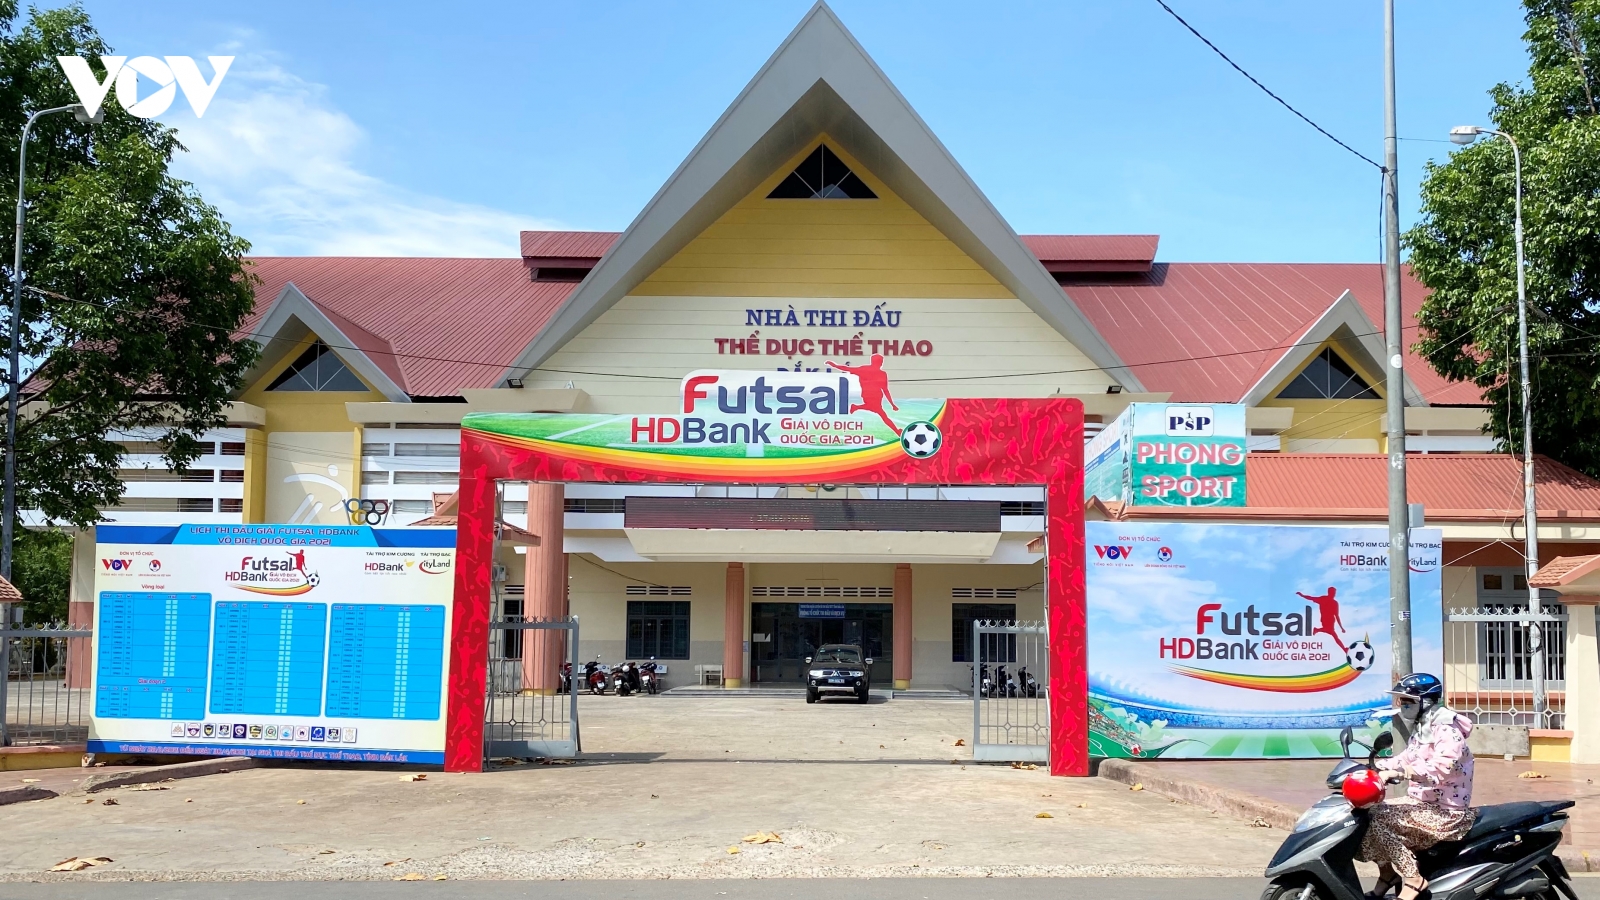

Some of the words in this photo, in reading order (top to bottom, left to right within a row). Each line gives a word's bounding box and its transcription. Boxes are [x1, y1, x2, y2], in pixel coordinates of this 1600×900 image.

[745, 305, 800, 326] NHÀ
[804, 310, 847, 326] THI
[853, 302, 902, 328] ĐẤU
[714, 330, 760, 355] THỂ
[766, 338, 814, 360] DỤC
[818, 332, 864, 356] THỂ
[868, 340, 934, 356] THAO
[684, 376, 850, 414] Futsal
[631, 417, 772, 444] HDBank
[780, 418, 808, 430] GIẢI
[812, 418, 831, 430] VÔ
[834, 420, 863, 432] ĐỊCH
[780, 432, 817, 444] QUỐC
[820, 434, 842, 444] GIA
[844, 435, 874, 445] 2021
[1137, 442, 1243, 465] PHONG
[1142, 475, 1237, 498] SPORT
[1094, 545, 1133, 560] VOV
[102, 559, 132, 570] VOV
[241, 556, 292, 571] Futsal
[365, 563, 404, 571] HDBank
[1340, 555, 1387, 566] HDBank
[225, 572, 268, 581] HDBank
[1197, 604, 1312, 636] Futsal
[1160, 637, 1259, 660] HDBank
[1262, 639, 1283, 650] GIẢI
[1285, 639, 1299, 650] VÔ
[1301, 641, 1322, 651] ĐỊCH
[1262, 650, 1288, 661] QUỐC
